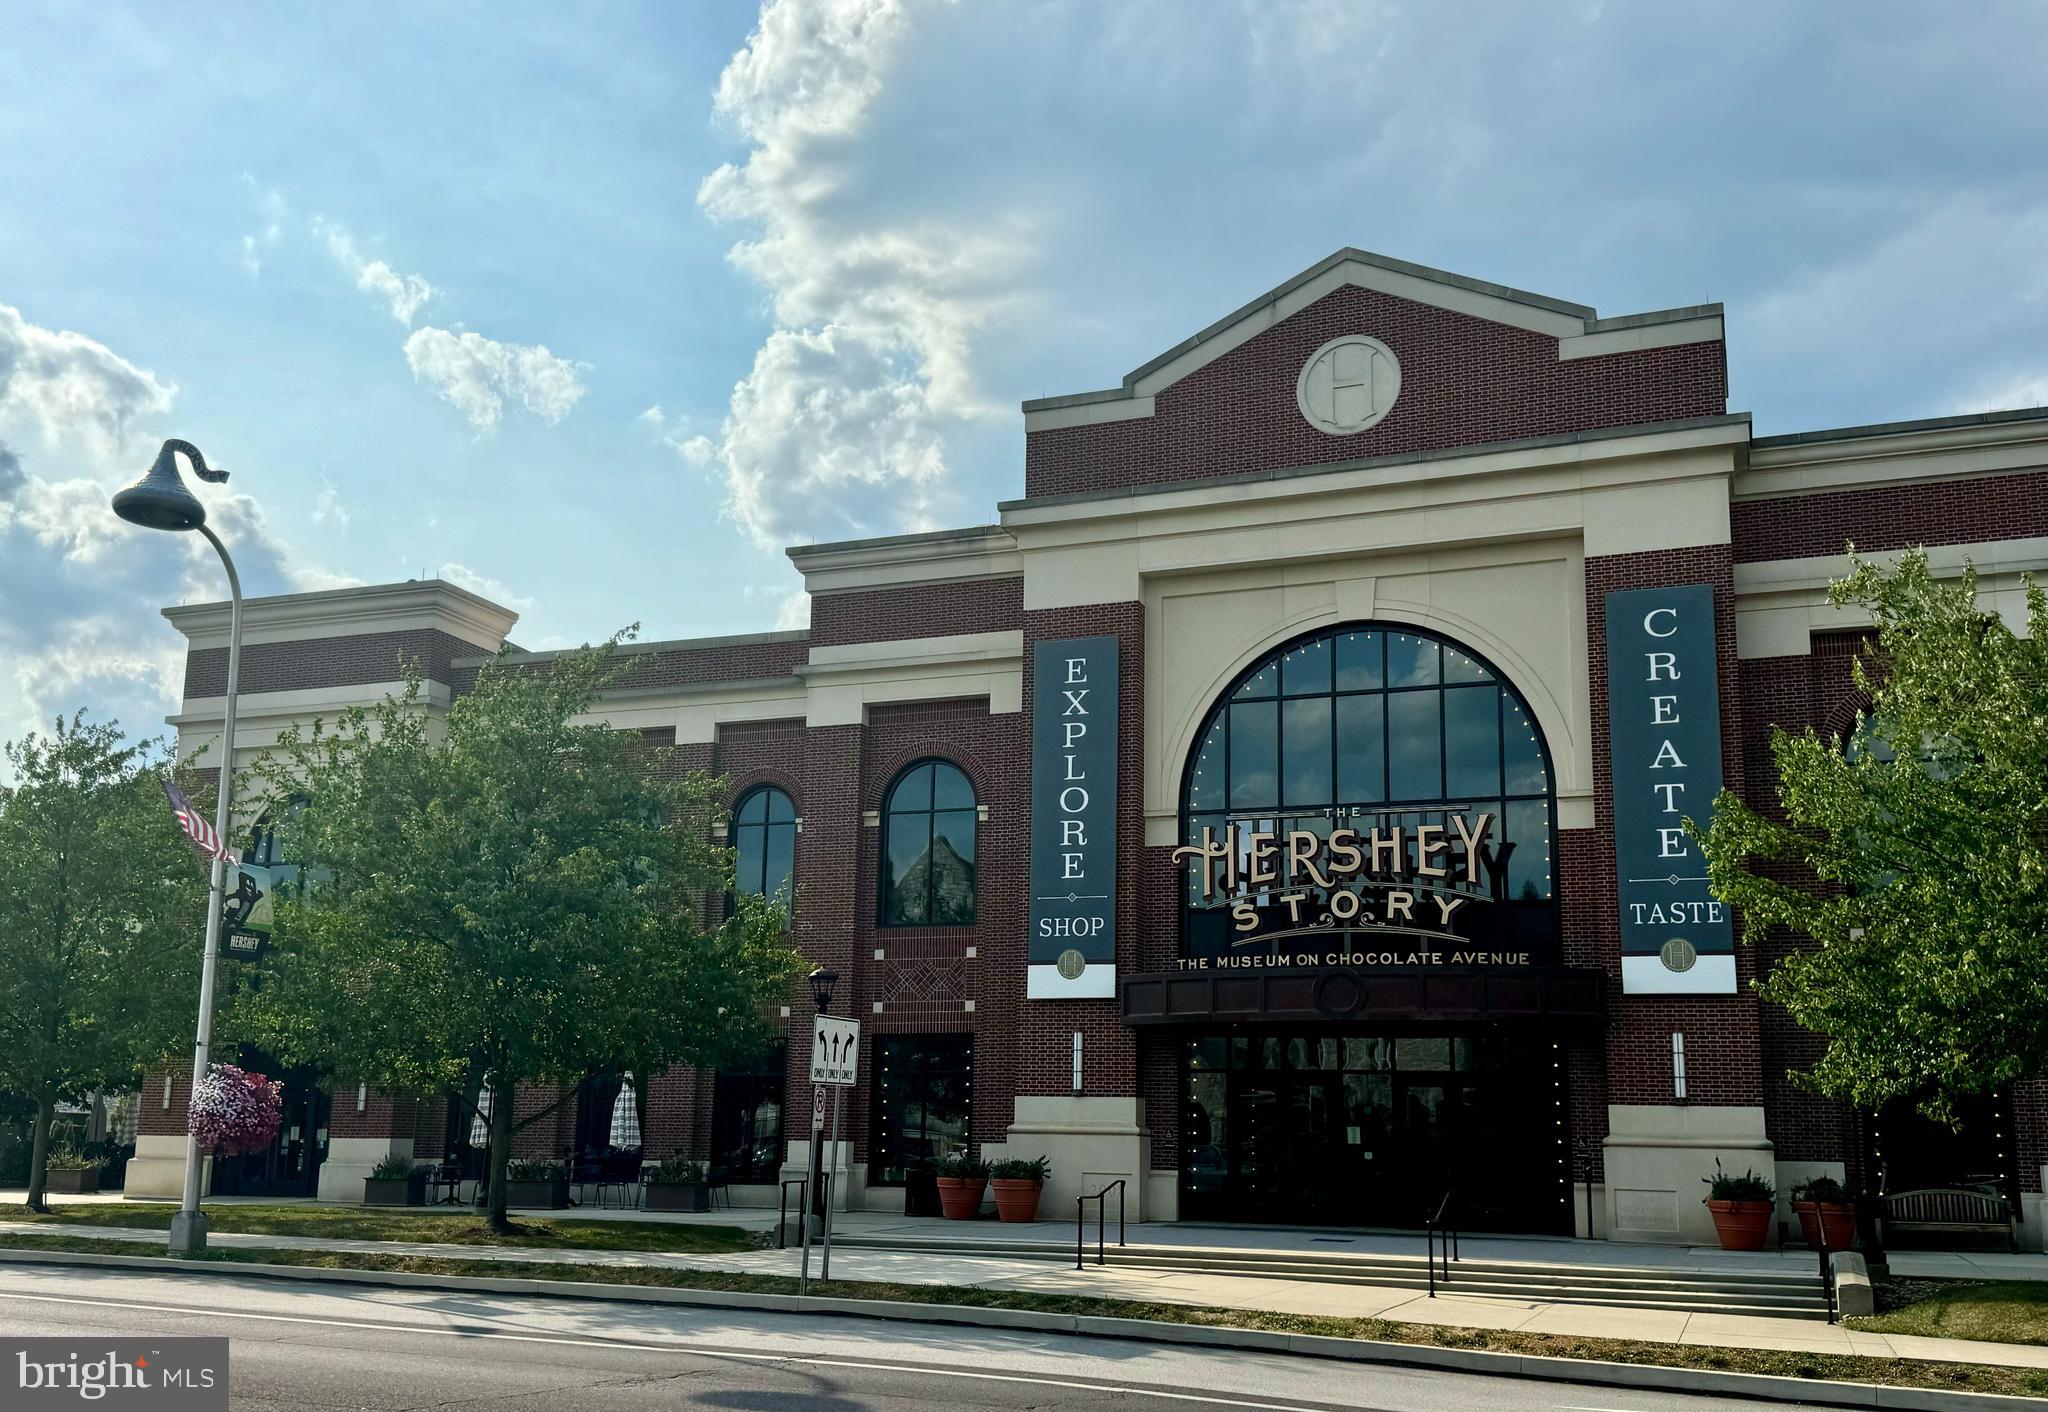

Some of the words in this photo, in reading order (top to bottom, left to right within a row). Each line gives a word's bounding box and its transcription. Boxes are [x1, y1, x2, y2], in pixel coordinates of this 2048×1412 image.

[1643, 608, 1688, 858] CREATE
[1059, 657, 1090, 880] EXPLORE
[1323, 807, 1361, 818] THE
[1171, 813, 1490, 898] HERSHEY
[1232, 890, 1464, 932] STORY
[1630, 901, 1724, 925] TASTE
[1039, 917, 1105, 938] SHOP
[230, 935, 260, 949] HERSHEY
[1177, 957, 1209, 971] THE
[1216, 954, 1291, 969] MUSEUM
[1296, 953, 1319, 967] ON
[1325, 952, 1443, 966] CHOCOLATE
[1450, 951, 1530, 966] AVENUE
[814, 1068, 825, 1078] ONLY
[828, 1069, 838, 1079] ONLY
[842, 1070, 853, 1080] ONLY
